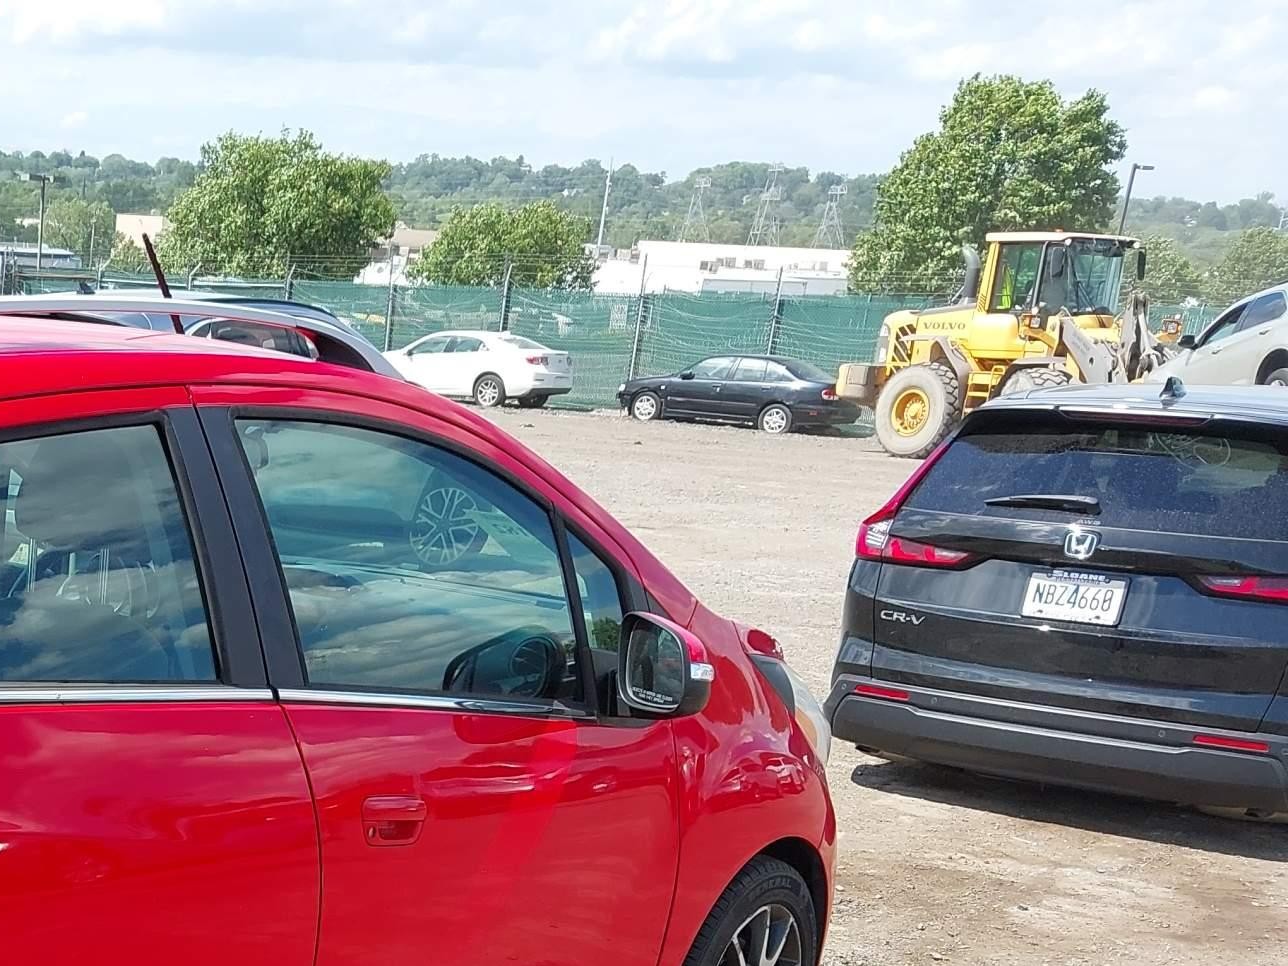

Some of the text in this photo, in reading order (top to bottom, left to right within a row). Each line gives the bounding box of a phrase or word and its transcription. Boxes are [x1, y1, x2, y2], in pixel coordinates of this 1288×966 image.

[923, 322, 966, 330] VOLVO
[1052, 569, 1106, 582] SLOANE
[1032, 582, 1114, 612] NBZ4660
[880, 610, 926, 625] CR-V
